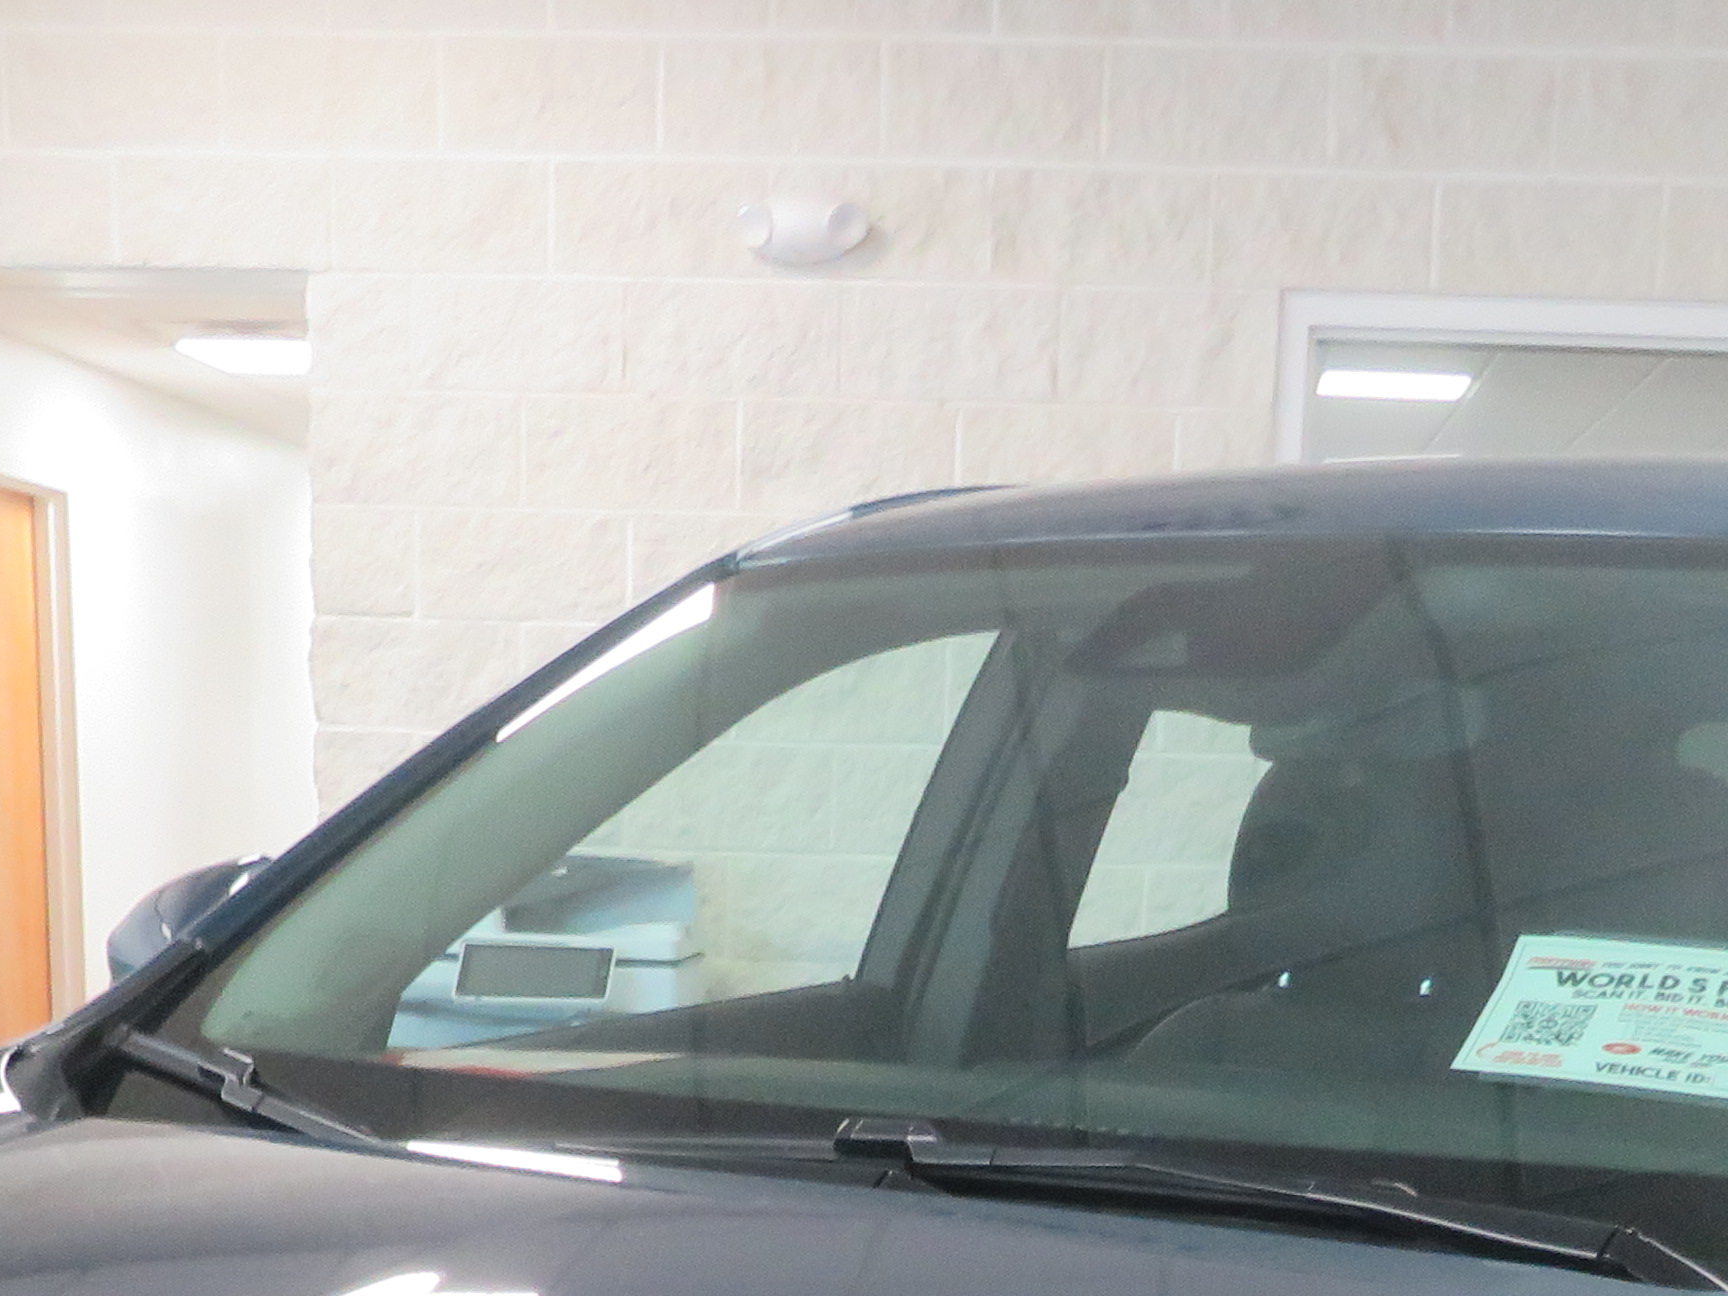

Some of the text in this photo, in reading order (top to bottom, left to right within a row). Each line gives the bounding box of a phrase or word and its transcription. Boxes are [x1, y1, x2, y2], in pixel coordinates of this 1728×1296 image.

[1571, 989, 1625, 1000] SCAN
[1653, 991, 1684, 1003] BID
[1594, 1061, 1679, 1081] VEHICLE
